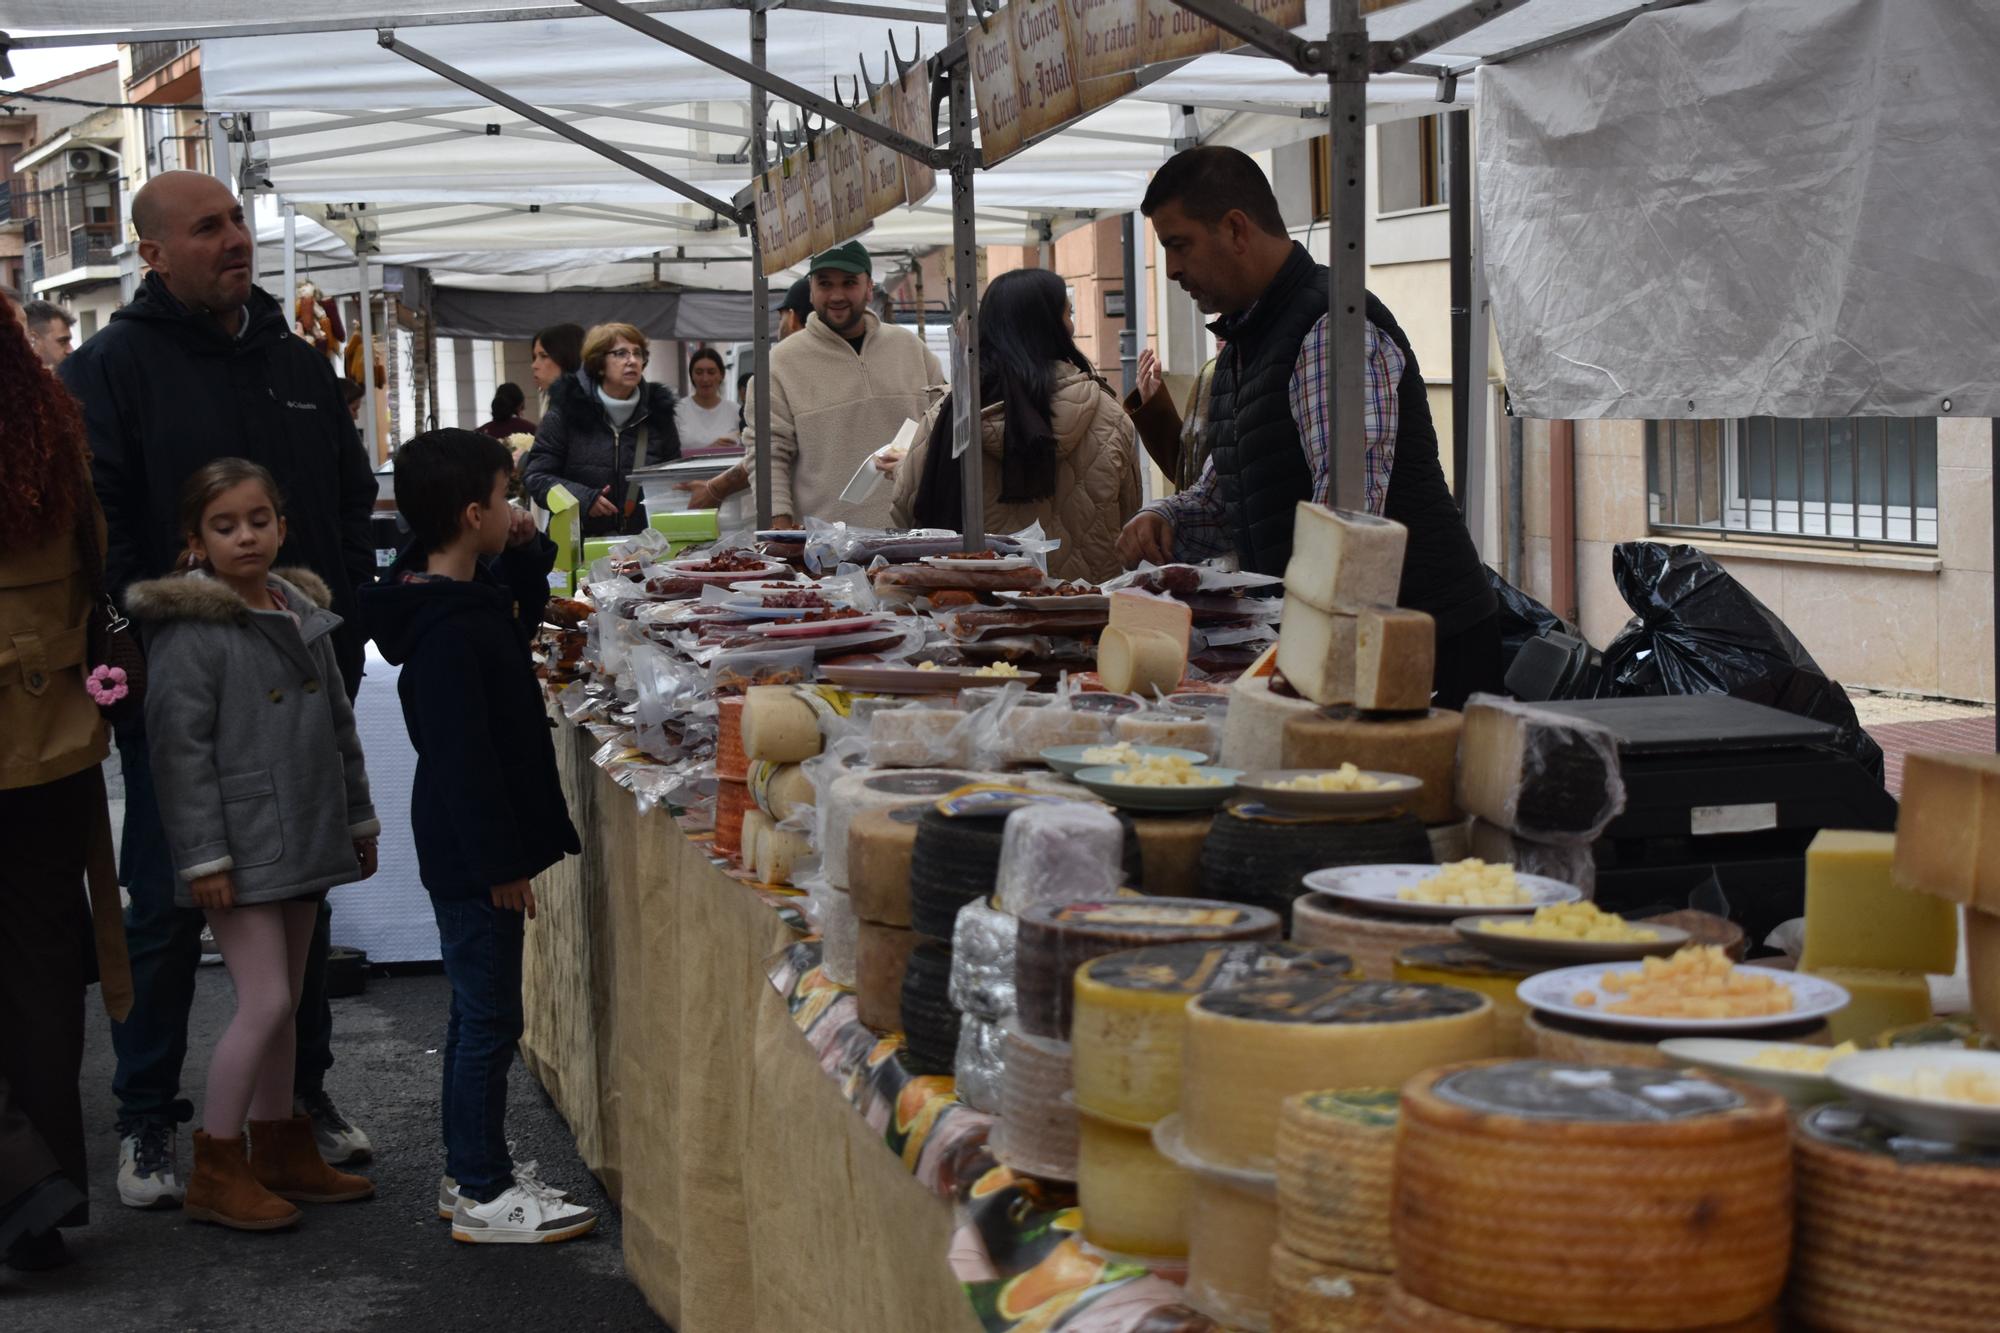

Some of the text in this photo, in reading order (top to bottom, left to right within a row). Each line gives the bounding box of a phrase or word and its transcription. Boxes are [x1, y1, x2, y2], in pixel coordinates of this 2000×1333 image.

[1019, 4, 1060, 52] Chorizo
[1086, 18, 1136, 56] de cabra
[1147, 9, 1164, 40] de
[975, 40, 1009, 82] Chorizo
[1019, 78, 1033, 110] de
